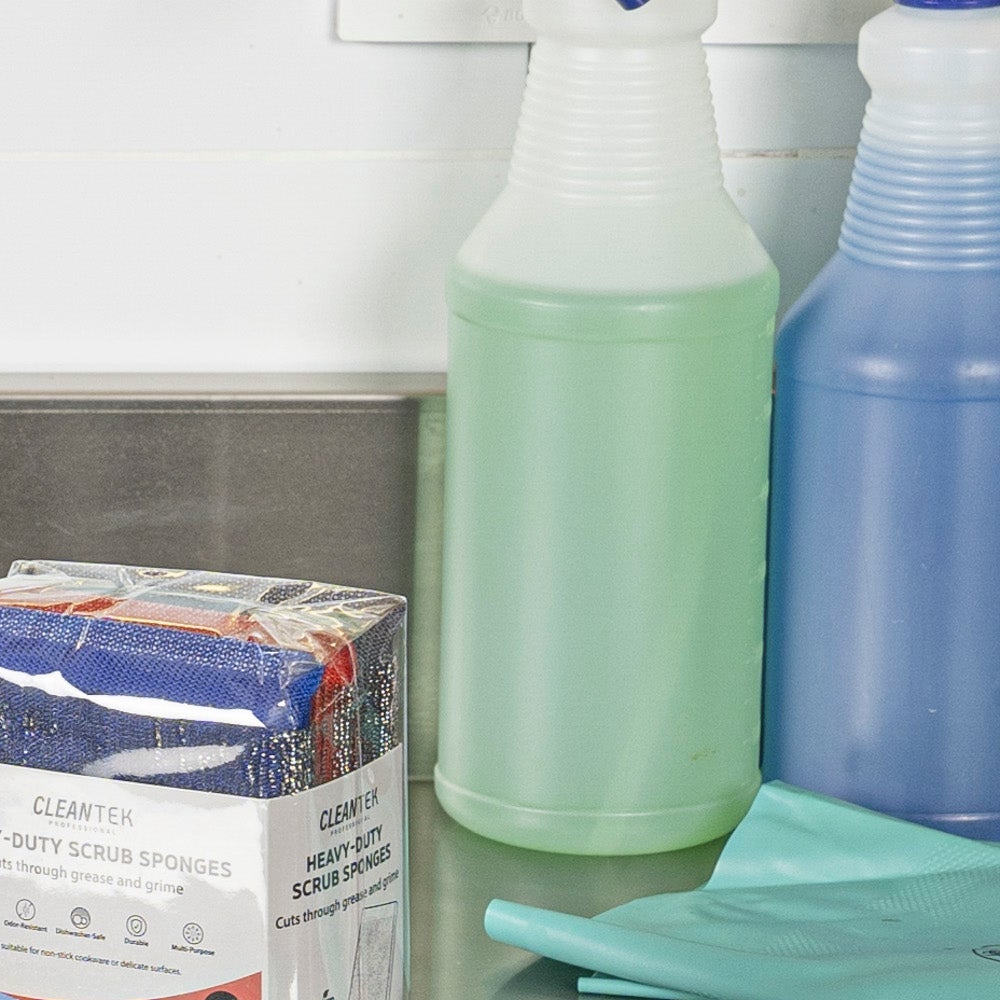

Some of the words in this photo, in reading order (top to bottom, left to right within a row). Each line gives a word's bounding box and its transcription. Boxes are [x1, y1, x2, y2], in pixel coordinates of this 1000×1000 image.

[33, 796, 134, 827] CLEANTEK
[319, 787, 379, 832] CLEANTEK
[68, 841, 133, 865] SCRUB
[139, 851, 232, 878] SPONGES
[306, 824, 383, 873] HEAVY-DUTY
[16, 860, 67, 880] through
[71, 869, 113, 885] grease
[117, 876, 141, 889] and
[145, 879, 184, 895] grime
[292, 869, 339, 900] SCRUB
[342, 843, 391, 882] SPONGES
[275, 914, 300, 930] Cuts
[303, 899, 340, 923] through
[342, 888, 367, 911] grease
[368, 878, 382, 896] and
[382, 869, 399, 891] grime
[1, 942, 28, 954] suitable
[29, 946, 39, 955] for
[41, 948, 73, 960] non-stick
[75, 953, 109, 965] cookware
[111, 959, 119, 967] or
[120, 959, 148, 971] delicate
[124, 937, 149, 947] Durable
